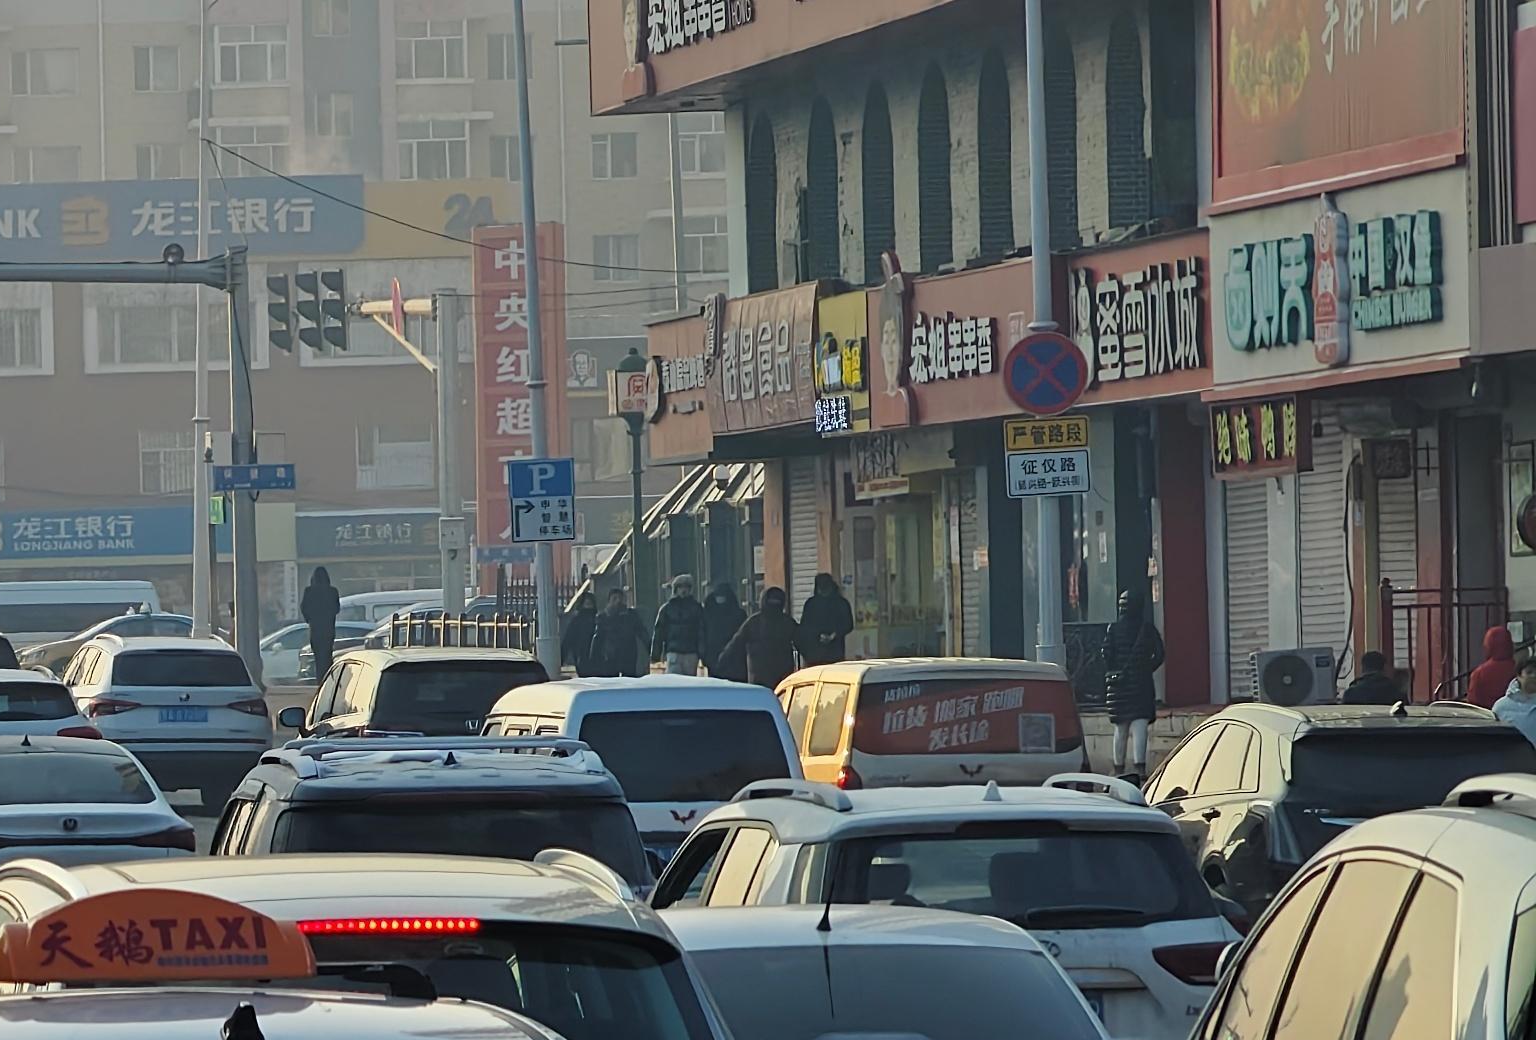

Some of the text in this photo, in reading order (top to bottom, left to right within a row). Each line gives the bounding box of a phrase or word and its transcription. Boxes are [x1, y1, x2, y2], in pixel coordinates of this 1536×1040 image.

[132, 198, 316, 237] 龙江银行
[1096, 256, 1200, 382] 蜜雪冰城
[1012, 423, 1082, 445] 严管路段
[528, 463, 556, 495] P
[1021, 457, 1076, 476] 征仪路
[13, 515, 135, 539] 龙江银行
[14, 538, 136, 552] LONGJIANG BANK
[40, 916, 267, 968] 天鹅 TAXI
